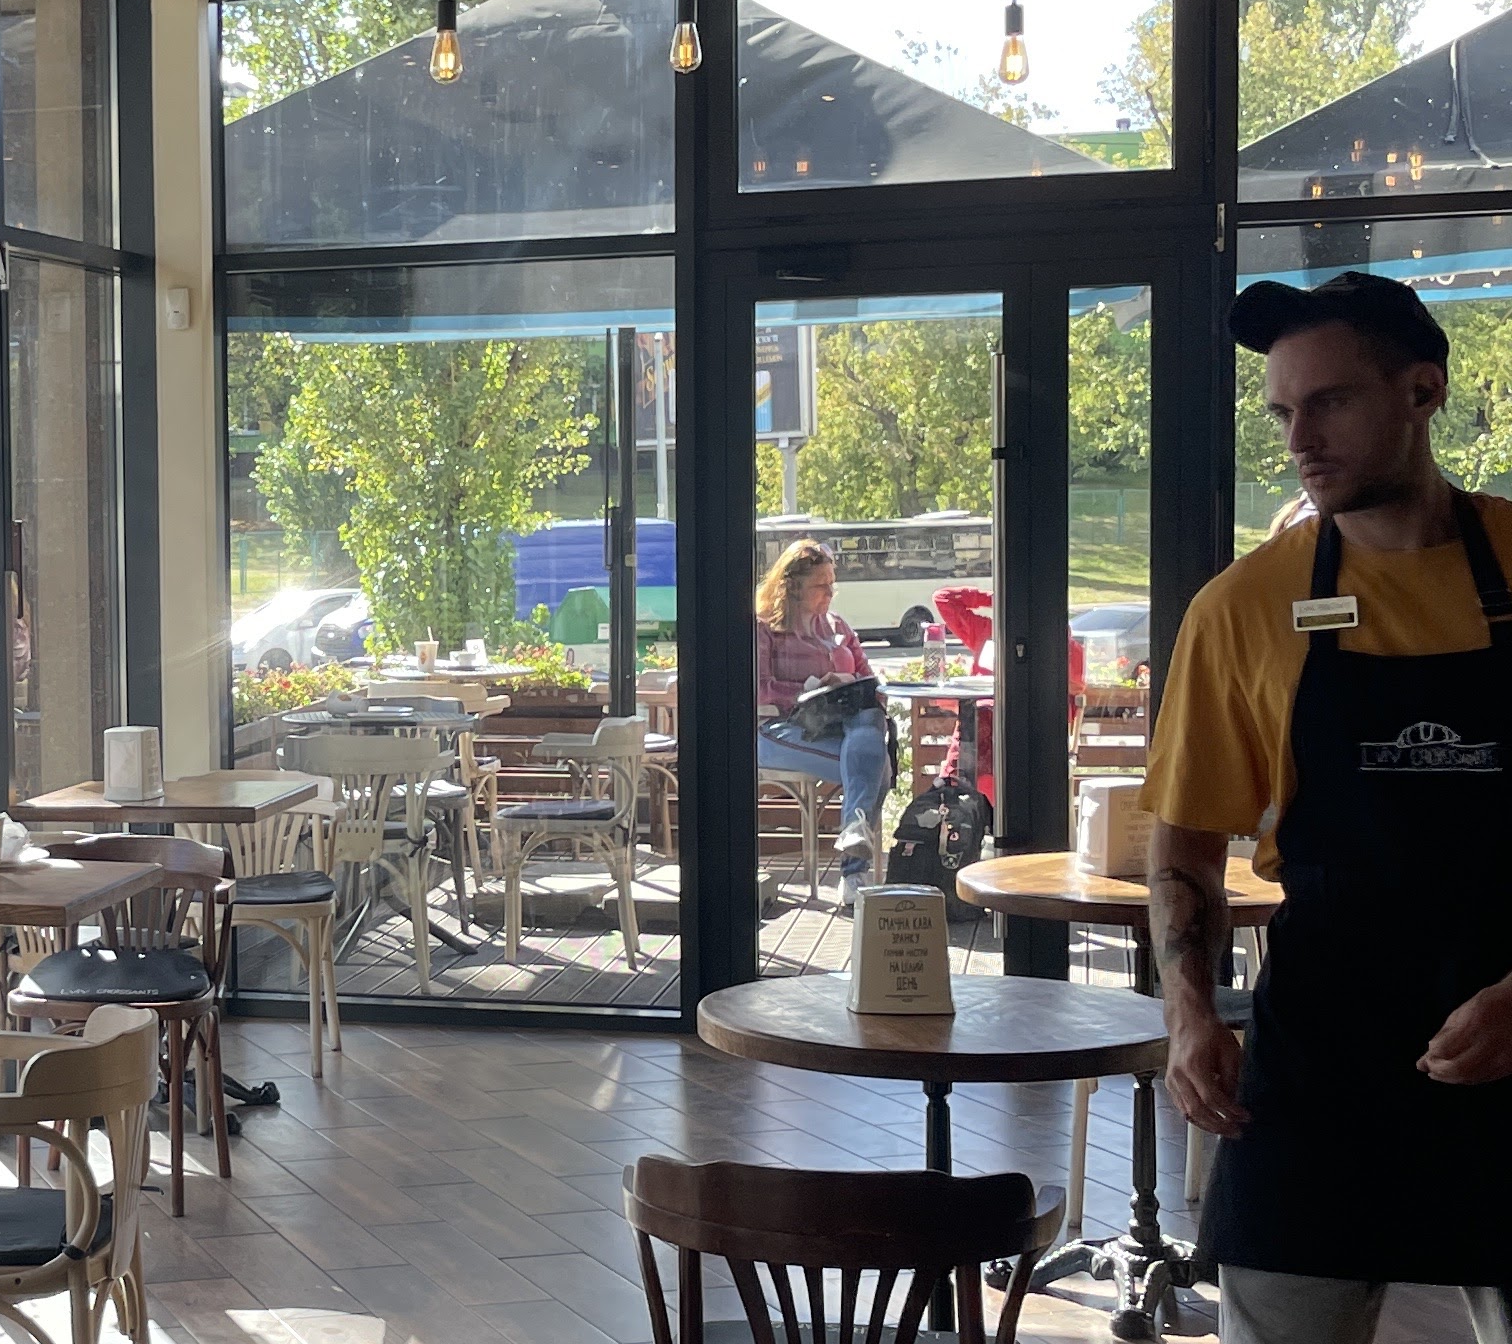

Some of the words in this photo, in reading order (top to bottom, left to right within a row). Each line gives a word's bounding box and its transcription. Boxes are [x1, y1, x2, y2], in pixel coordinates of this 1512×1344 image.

[878, 917, 910, 931] СМАЧНА
[913, 916, 933, 930] КАВА
[891, 933, 920, 944] ЗРАНКУ
[889, 961, 899, 973] НА
[896, 976, 918, 991] ДЕНЬ
